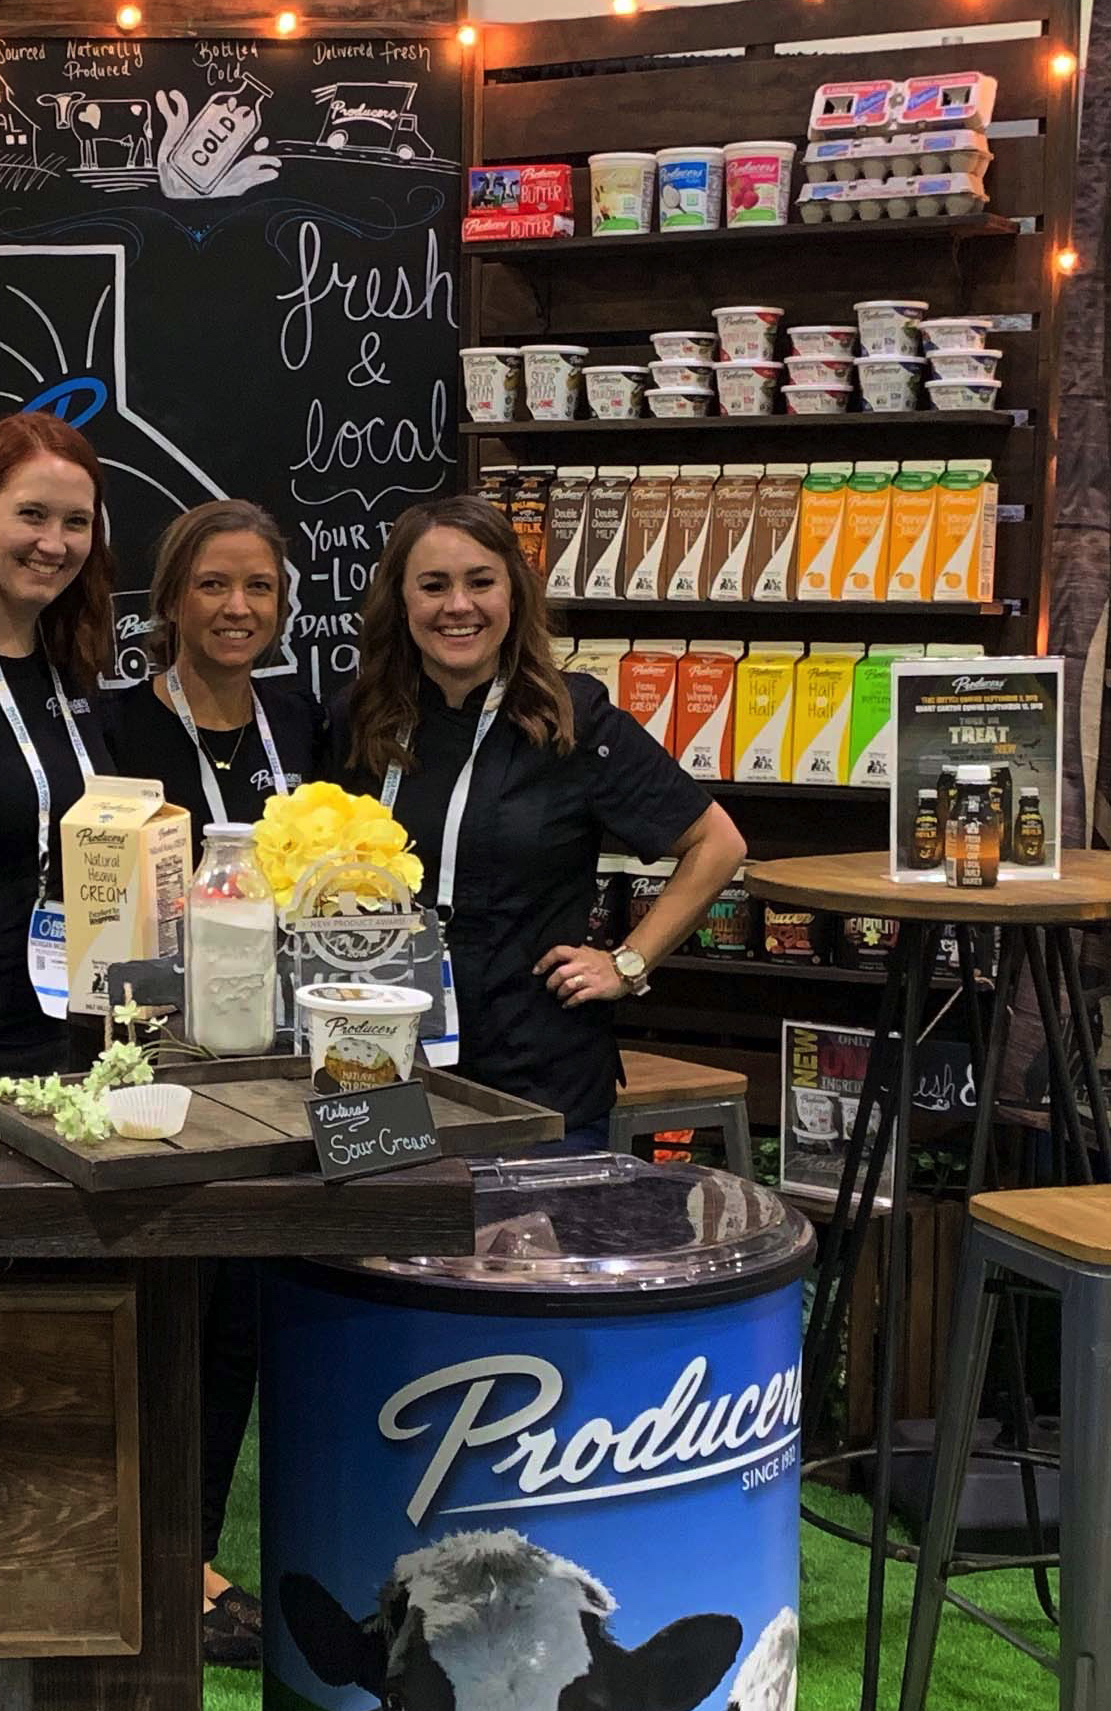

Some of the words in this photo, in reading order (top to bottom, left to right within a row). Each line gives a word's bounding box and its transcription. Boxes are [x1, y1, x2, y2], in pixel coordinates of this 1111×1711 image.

[66, 41, 143, 67] Naturally
[191, 41, 259, 67] Bottled
[312, 41, 375, 65] Delivered
[62, 61, 131, 80] Produced
[206, 63, 243, 86] Cold
[330, 100, 400, 120] Producers
[191, 116, 236, 167] COLD
[276, 221, 459, 370] fresh
[347, 331, 391, 387] &
[290, 379, 458, 473] local
[299, 520, 370, 561] YOUR
[749, 681, 776, 696] Half
[808, 682, 837, 697] Half
[749, 704, 776, 718] Half
[808, 704, 835, 719] Half
[948, 725, 1009, 744] TREAT
[76, 827, 128, 846] Producers
[84, 852, 120, 868] Natural
[88, 868, 118, 886] Heavy
[325, 1017, 399, 1038] Producers
[792, 1029, 818, 1088] NEW
[327, 1134, 376, 1166] Sour
[378, 1128, 437, 1156] Cream
[742, 1457, 779, 1490] SINCE
